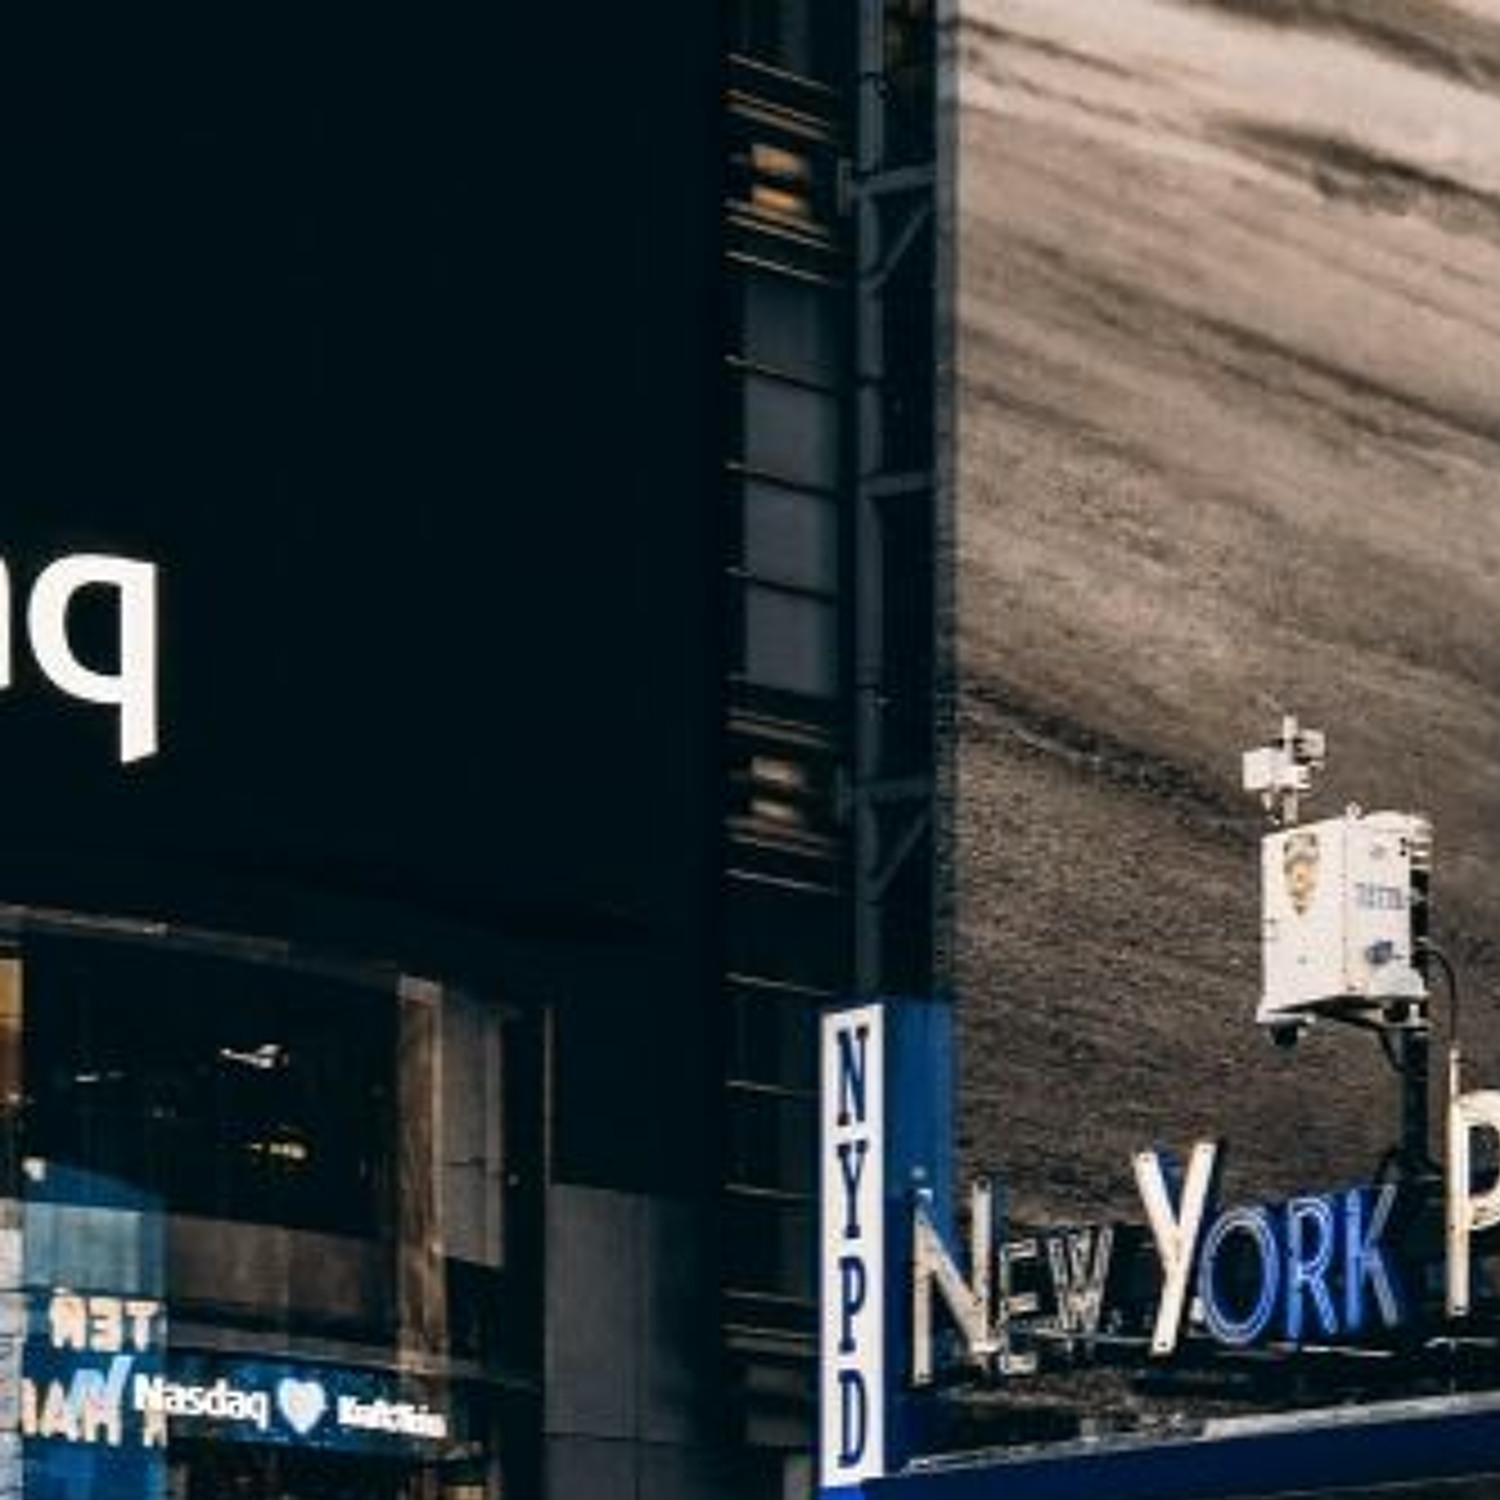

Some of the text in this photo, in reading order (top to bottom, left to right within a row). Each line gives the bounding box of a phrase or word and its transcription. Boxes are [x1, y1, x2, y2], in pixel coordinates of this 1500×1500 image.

[0, 552, 160, 763] q
[836, 1026, 869, 1471] NYPD
[912, 1178, 1114, 1386] NEW
[1132, 1141, 1399, 1355] YORK
[134, 1372, 269, 1431] Nasdaq
